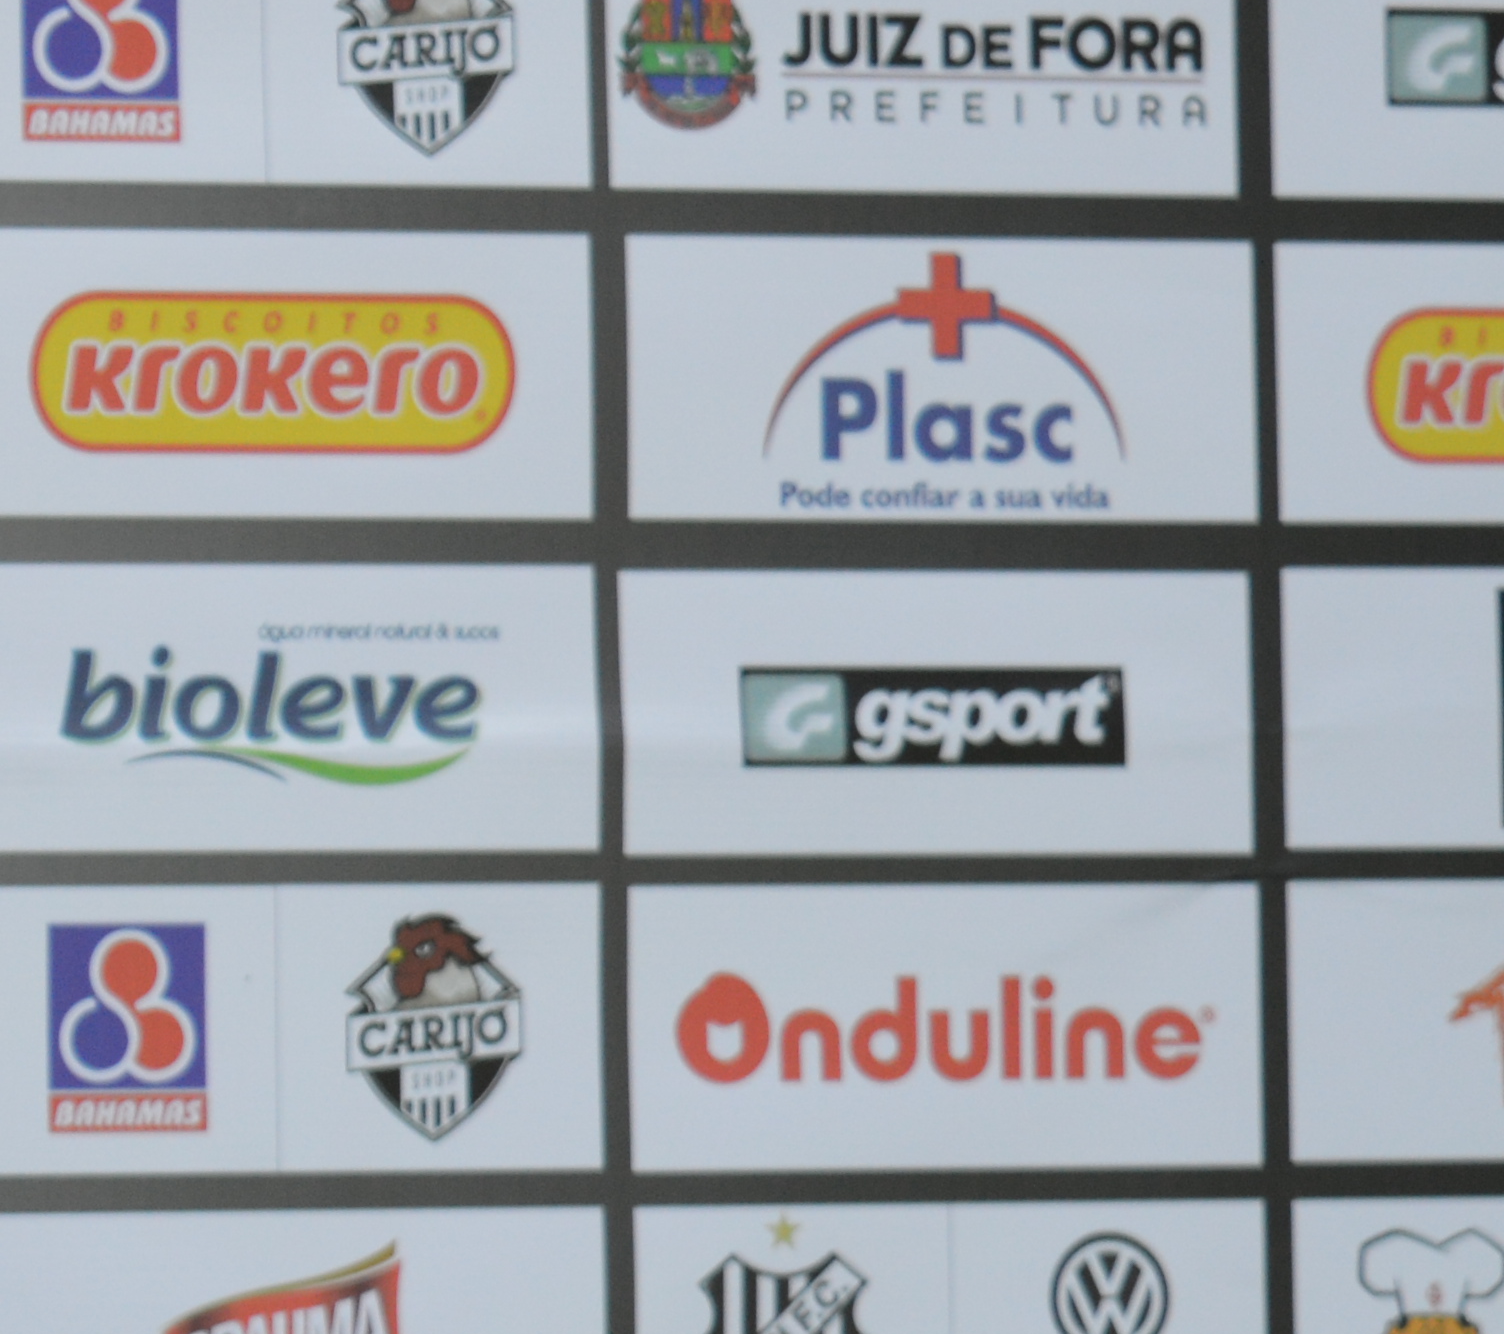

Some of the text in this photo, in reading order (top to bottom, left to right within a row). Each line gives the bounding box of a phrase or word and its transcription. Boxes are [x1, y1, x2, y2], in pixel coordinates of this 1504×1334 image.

[783, 12, 1204, 72] JUIZ DE FORA
[28, 106, 177, 140] BAHAMAS
[785, 88, 1208, 128] PREFEITURA
[108, 310, 440, 336] BISCOITOS
[821, 369, 1074, 464] Plasc
[780, 481, 1110, 509] Pode confiar a sua vida
[61, 645, 481, 743] bioleve
[854, 676, 1106, 759] gsport
[51, 1095, 204, 1129] BAHAMAS
